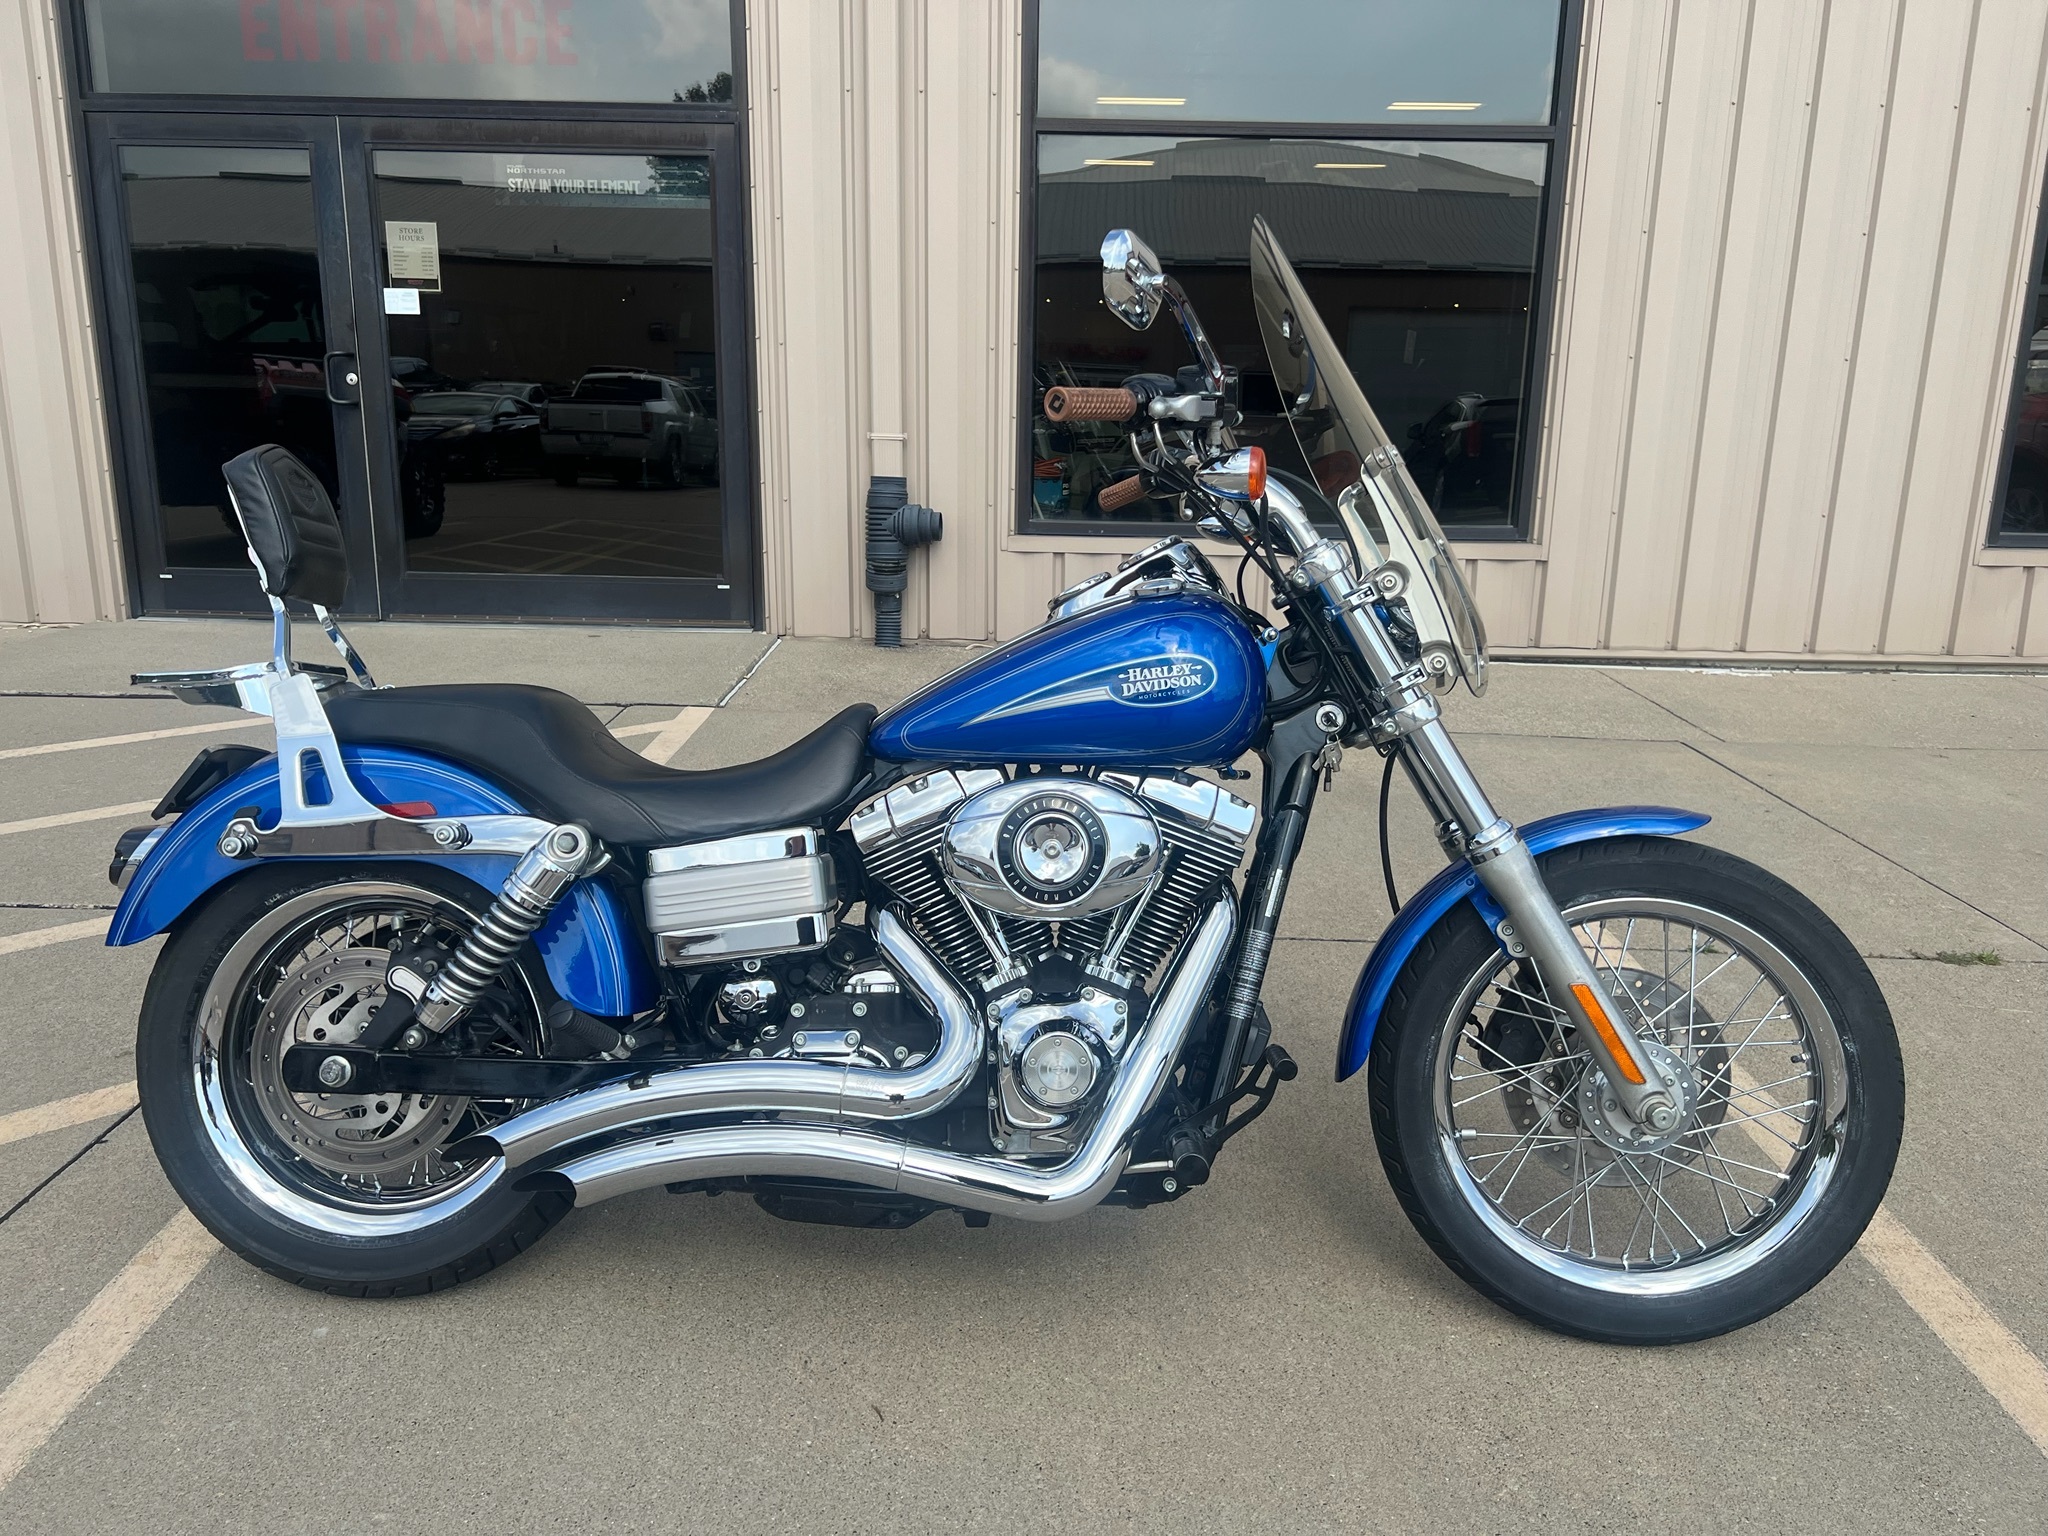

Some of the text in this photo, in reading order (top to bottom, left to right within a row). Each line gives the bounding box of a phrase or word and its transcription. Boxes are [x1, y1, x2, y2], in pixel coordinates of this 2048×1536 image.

[240, 0, 579, 66] ENTRANCE
[506, 167, 566, 175] NORTHSTAR
[507, 178, 641, 195] STAY IN YOUR ELEMENT
[399, 227, 424, 235] STORE
[1126, 663, 1194, 682] HARLEY
[1121, 674, 1203, 697] DAVIDSON
[1138, 689, 1191, 700] MOTORCYCLES
[1016, 799, 1055, 819] CUBIC
[1064, 801, 1101, 840] INCHES
